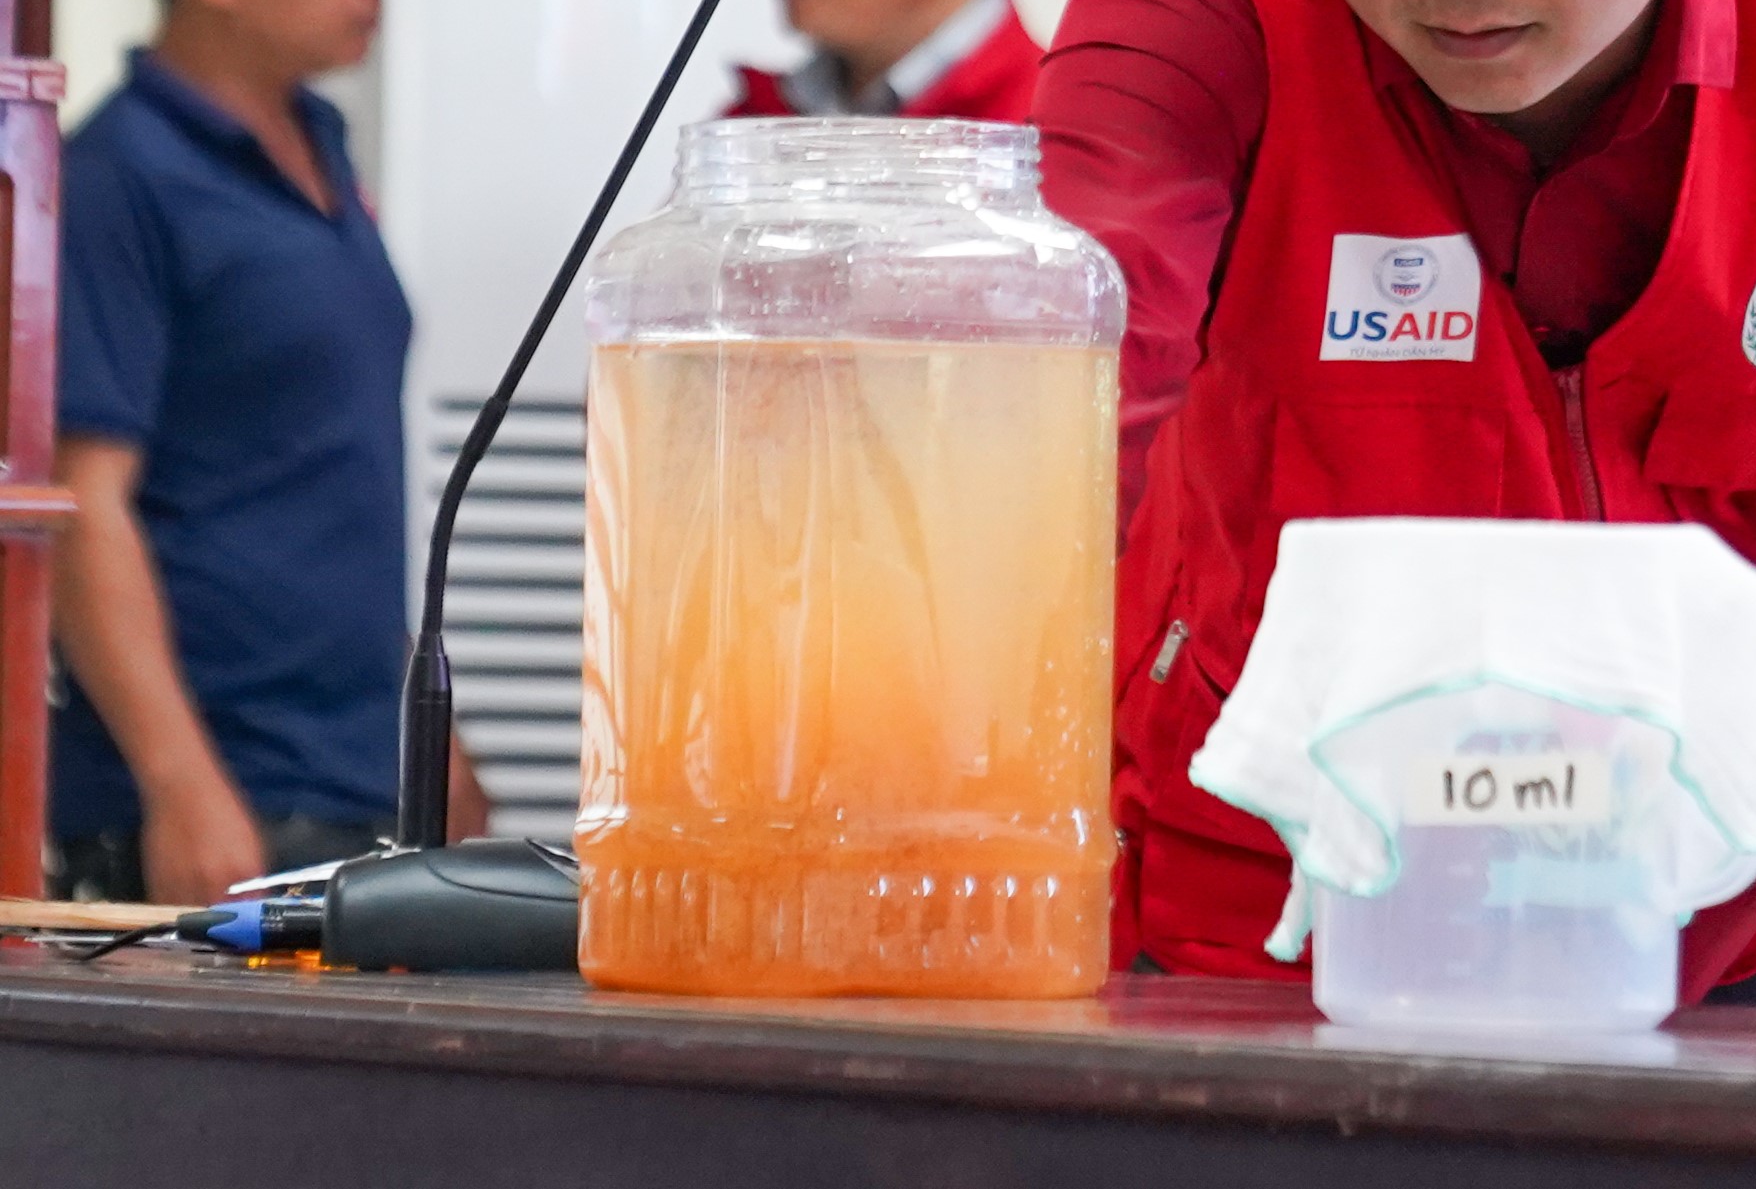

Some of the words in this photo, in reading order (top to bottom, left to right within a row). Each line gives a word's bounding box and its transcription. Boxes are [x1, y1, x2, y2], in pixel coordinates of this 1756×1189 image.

[1327, 310, 1474, 343] USAID
[1442, 768, 1498, 812] 10
[1513, 762, 1576, 811] ml
